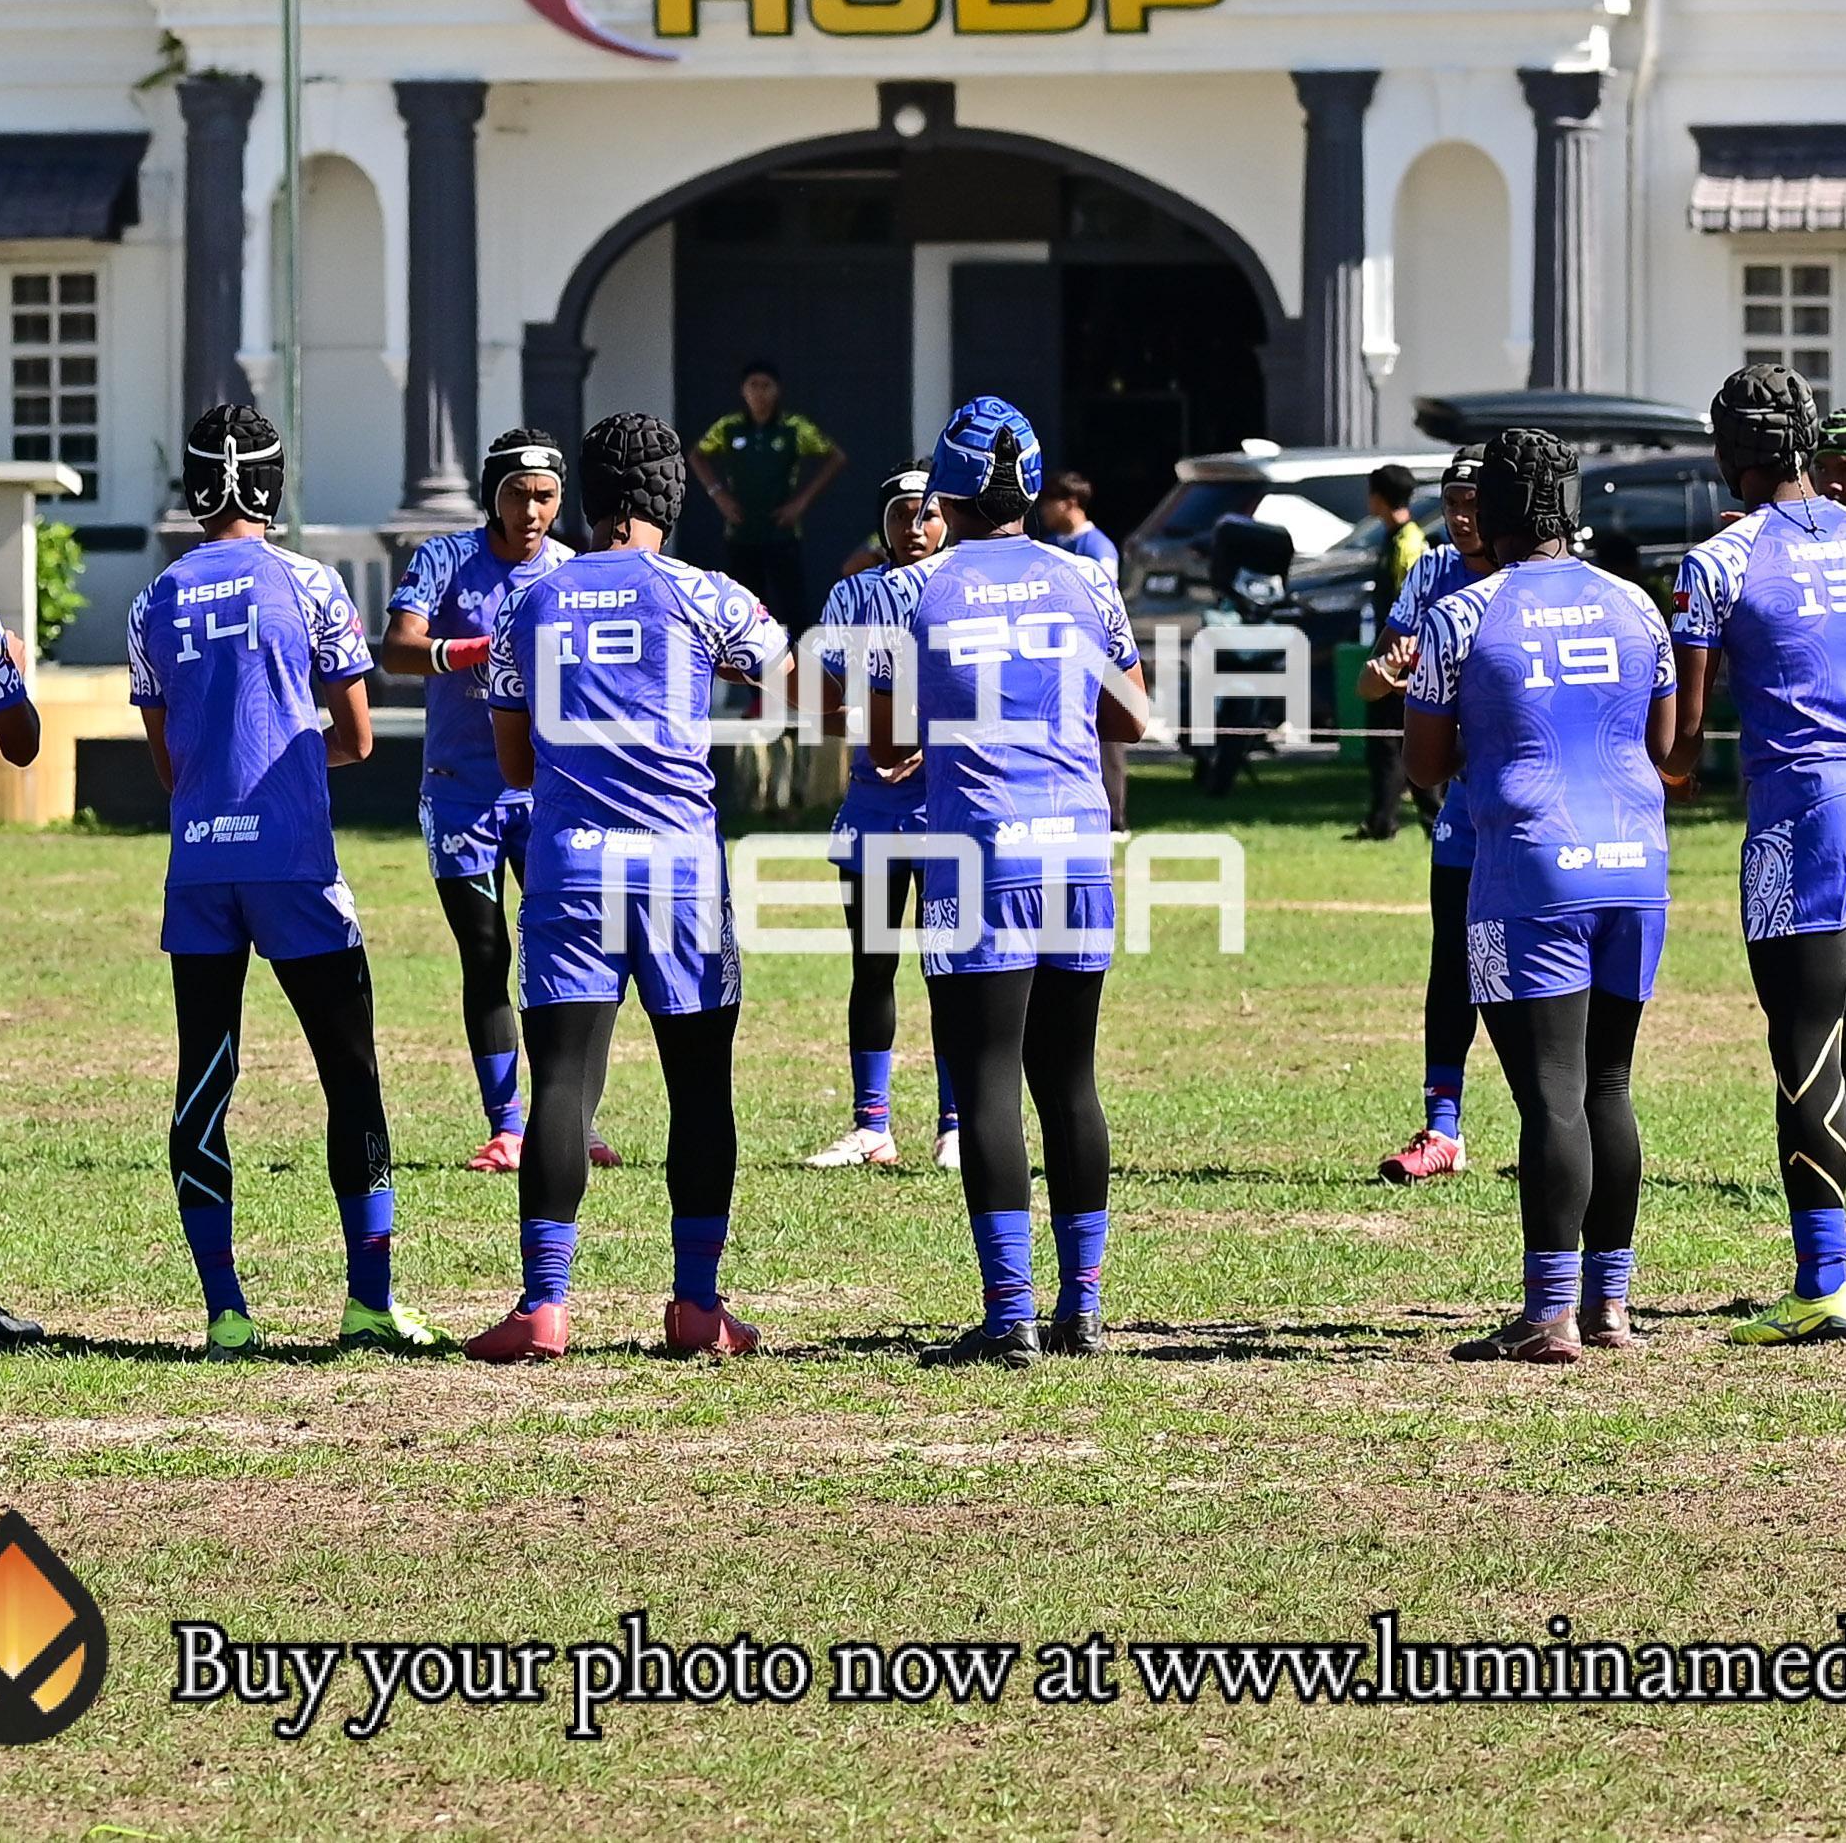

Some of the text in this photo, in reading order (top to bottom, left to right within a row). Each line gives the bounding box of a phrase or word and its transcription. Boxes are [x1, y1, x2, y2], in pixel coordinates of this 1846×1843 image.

[177, 575, 255, 606] HSBP
[558, 589, 637, 609] HSBP
[964, 580, 1051, 606] HSBP
[173, 604, 259, 664] 14
[1521, 604, 1604, 628] HSBP
[553, 619, 642, 665] 18
[946, 611, 1078, 667] 20
[1520, 637, 1620, 689] 19
